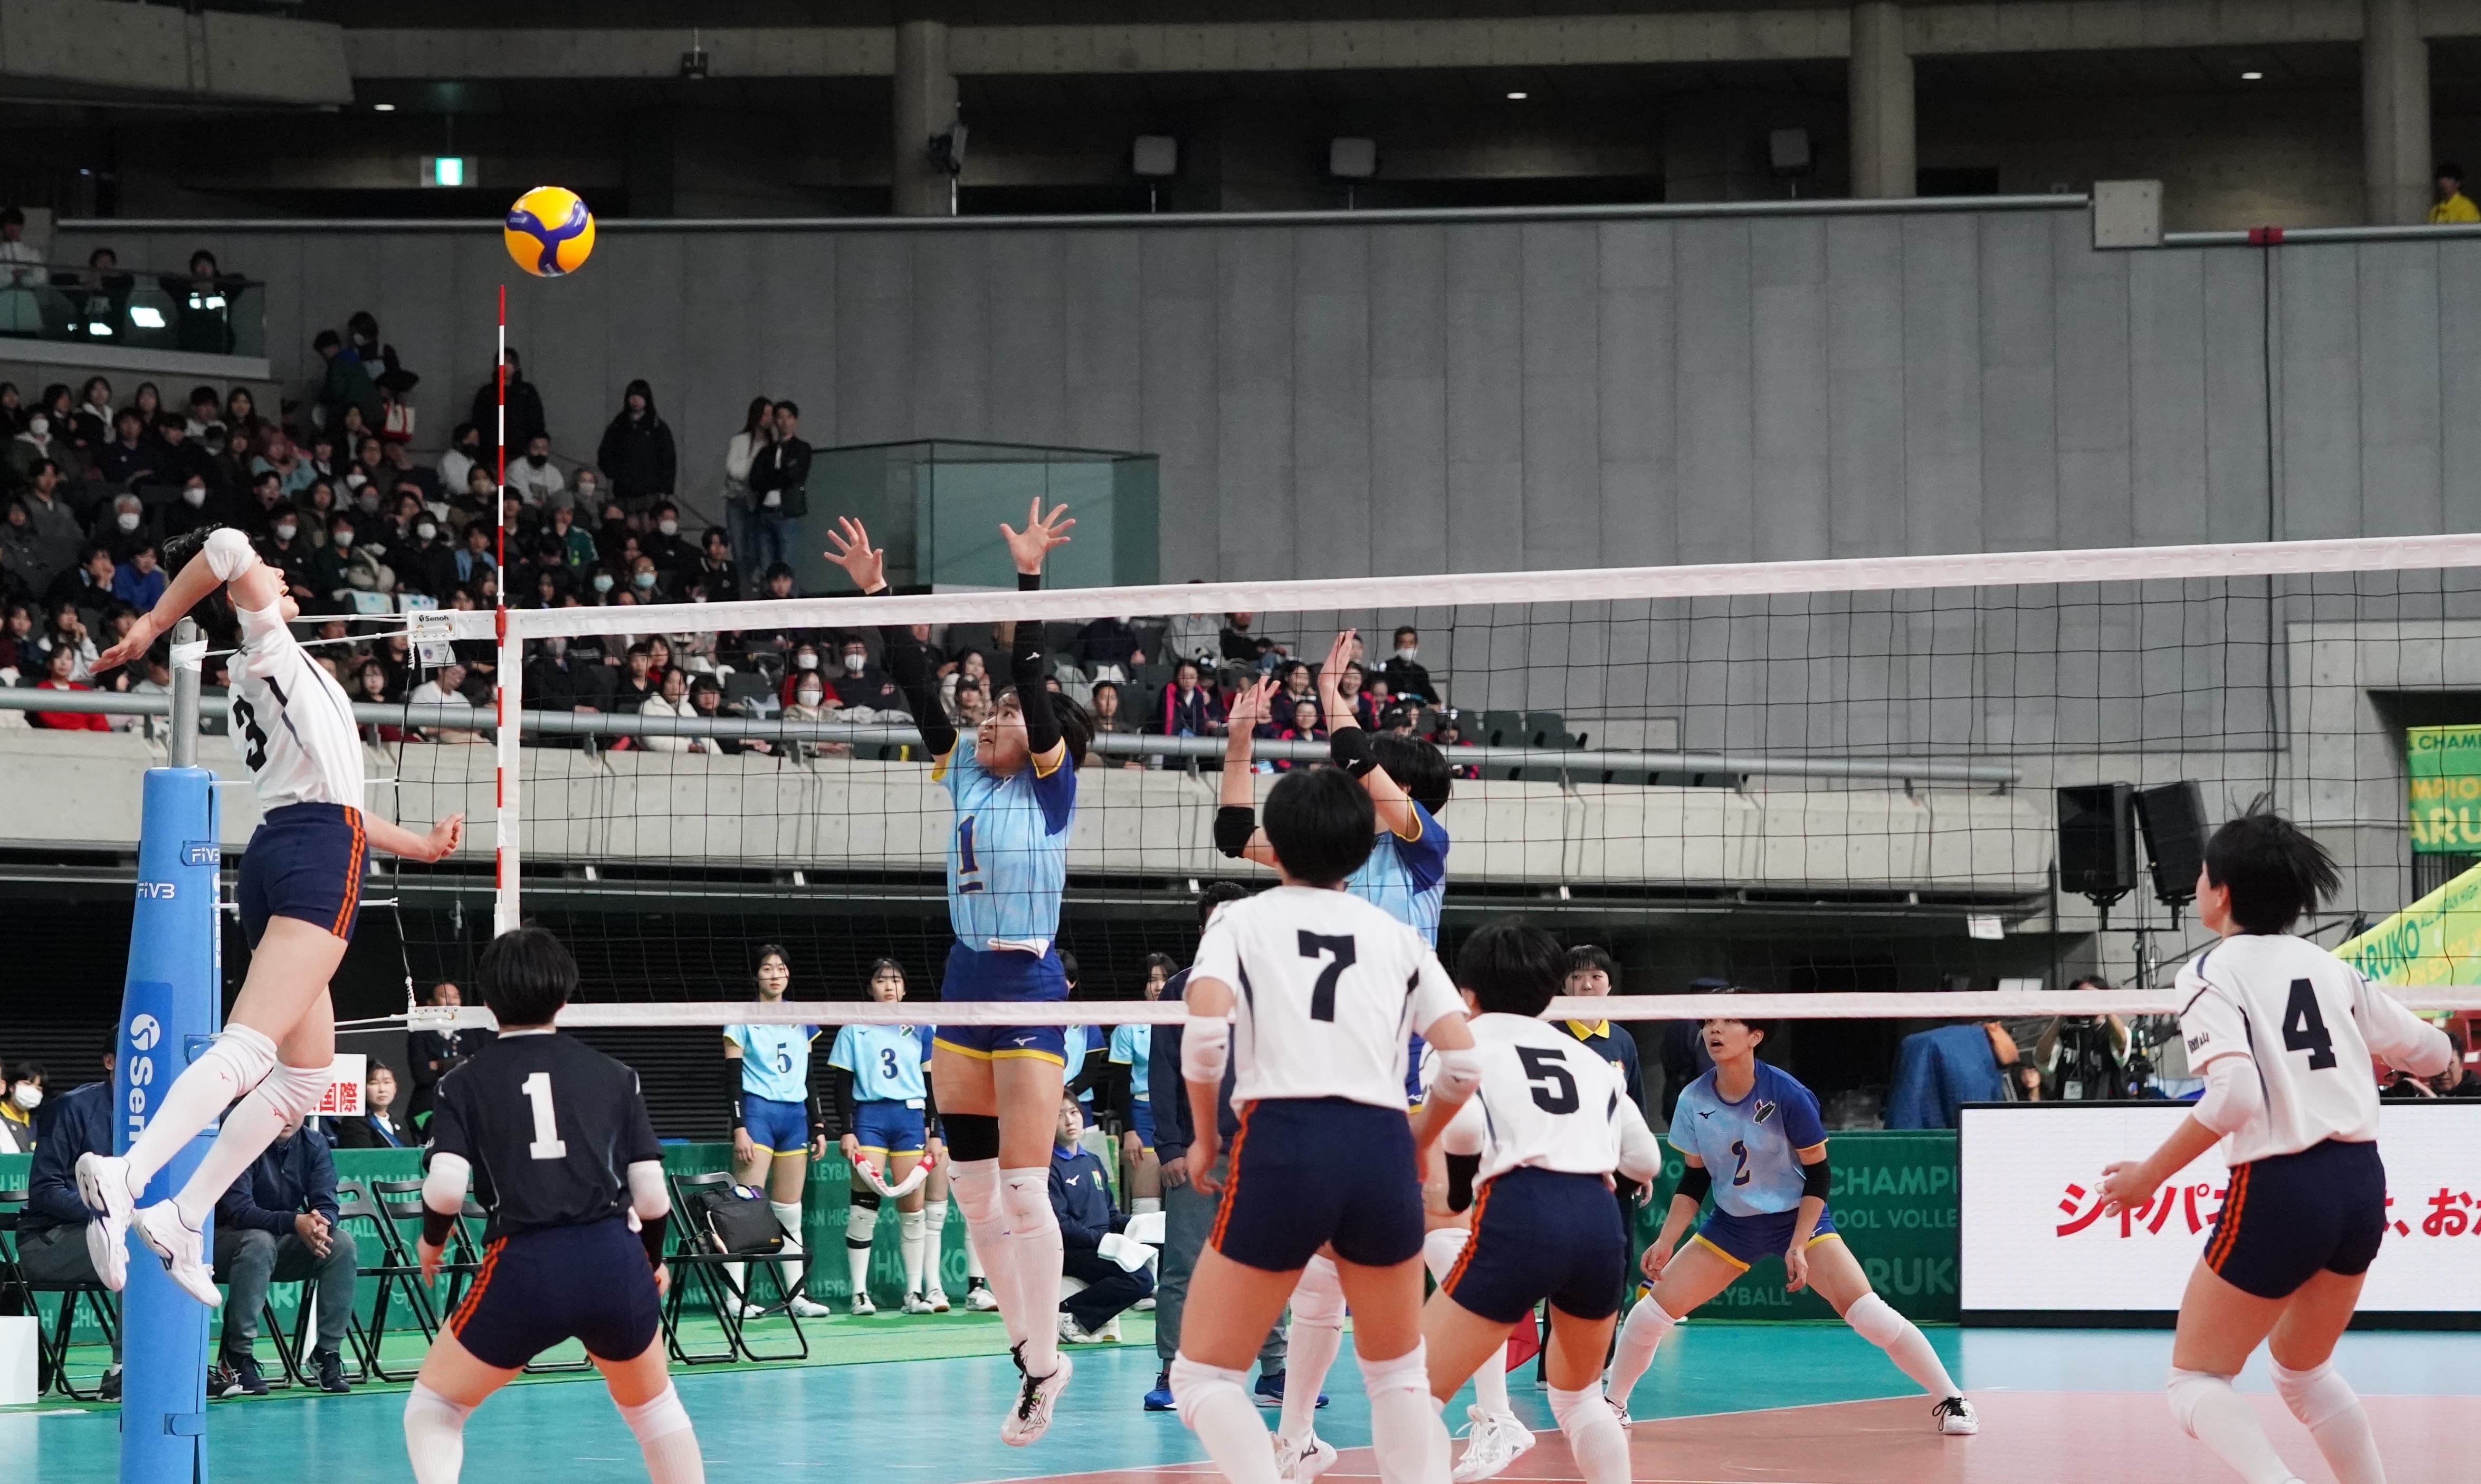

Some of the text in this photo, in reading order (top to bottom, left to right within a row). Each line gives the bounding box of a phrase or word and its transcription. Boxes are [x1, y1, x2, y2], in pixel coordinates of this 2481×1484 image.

[233, 694, 268, 772] 3
[958, 815, 979, 876] 1
[1297, 930, 1356, 1022] 7
[2282, 978, 2337, 1070] 4
[777, 1042, 791, 1074] 5
[881, 1048, 898, 1079] 3
[1515, 1046, 1579, 1115] 5
[313, 1082, 357, 1113] 国際
[521, 1072, 566, 1160] 1
[1731, 1140, 1751, 1186] 2
